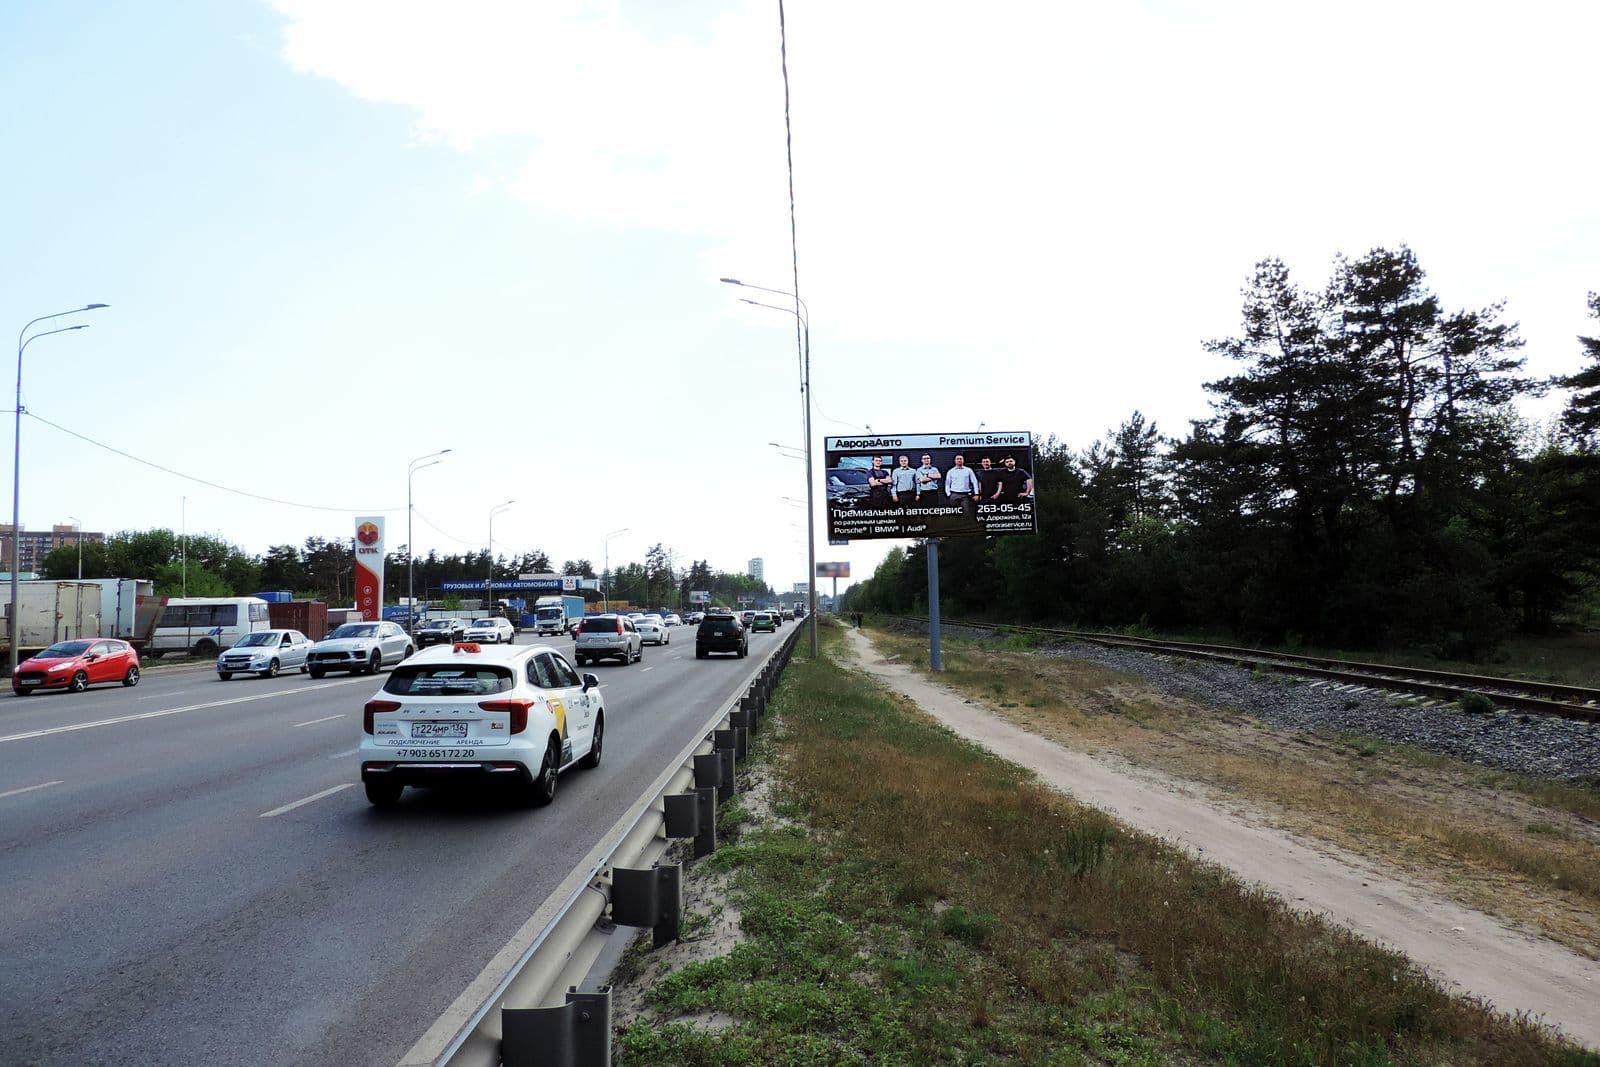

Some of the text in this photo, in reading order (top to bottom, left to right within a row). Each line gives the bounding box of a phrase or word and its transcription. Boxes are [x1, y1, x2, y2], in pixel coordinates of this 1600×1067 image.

[835, 439, 902, 448] АврораАвто
[939, 435, 1025, 446] Premium Service
[833, 506, 963, 518] Премиальный автосервис
[977, 503, 1031, 513] 263-05-45
[397, 749, 407, 757] +7
[410, 749, 427, 757] 903
[448, 749, 460, 757] 72
[462, 749, 475, 758] 20
